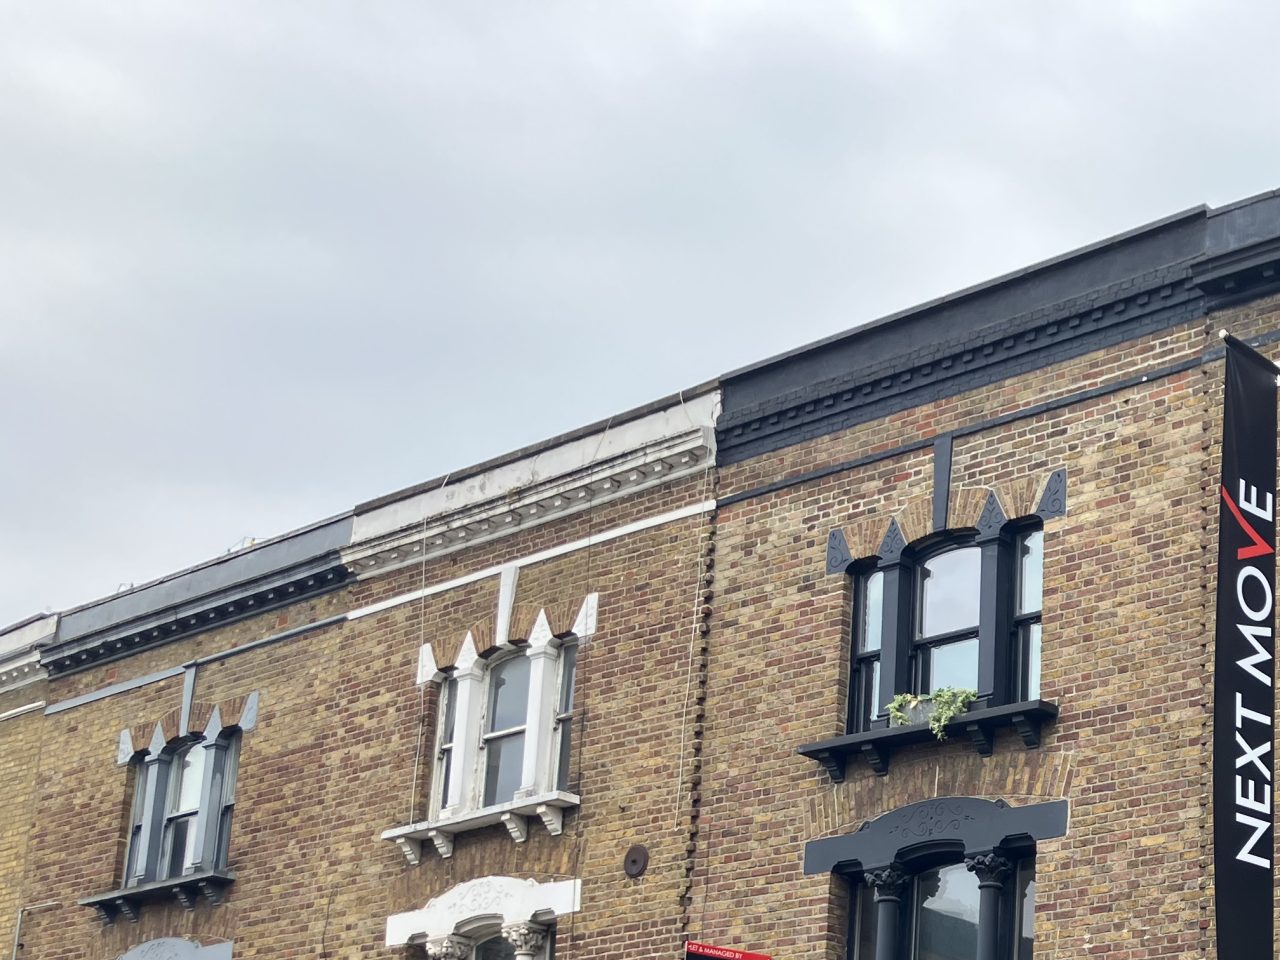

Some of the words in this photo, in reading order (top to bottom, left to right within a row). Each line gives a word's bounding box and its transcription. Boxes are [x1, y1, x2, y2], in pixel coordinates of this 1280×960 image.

[1221, 478, 1275, 688] MOVE
[1235, 691, 1272, 869] NEXT
[704, 948, 735, 958] MANAGED
